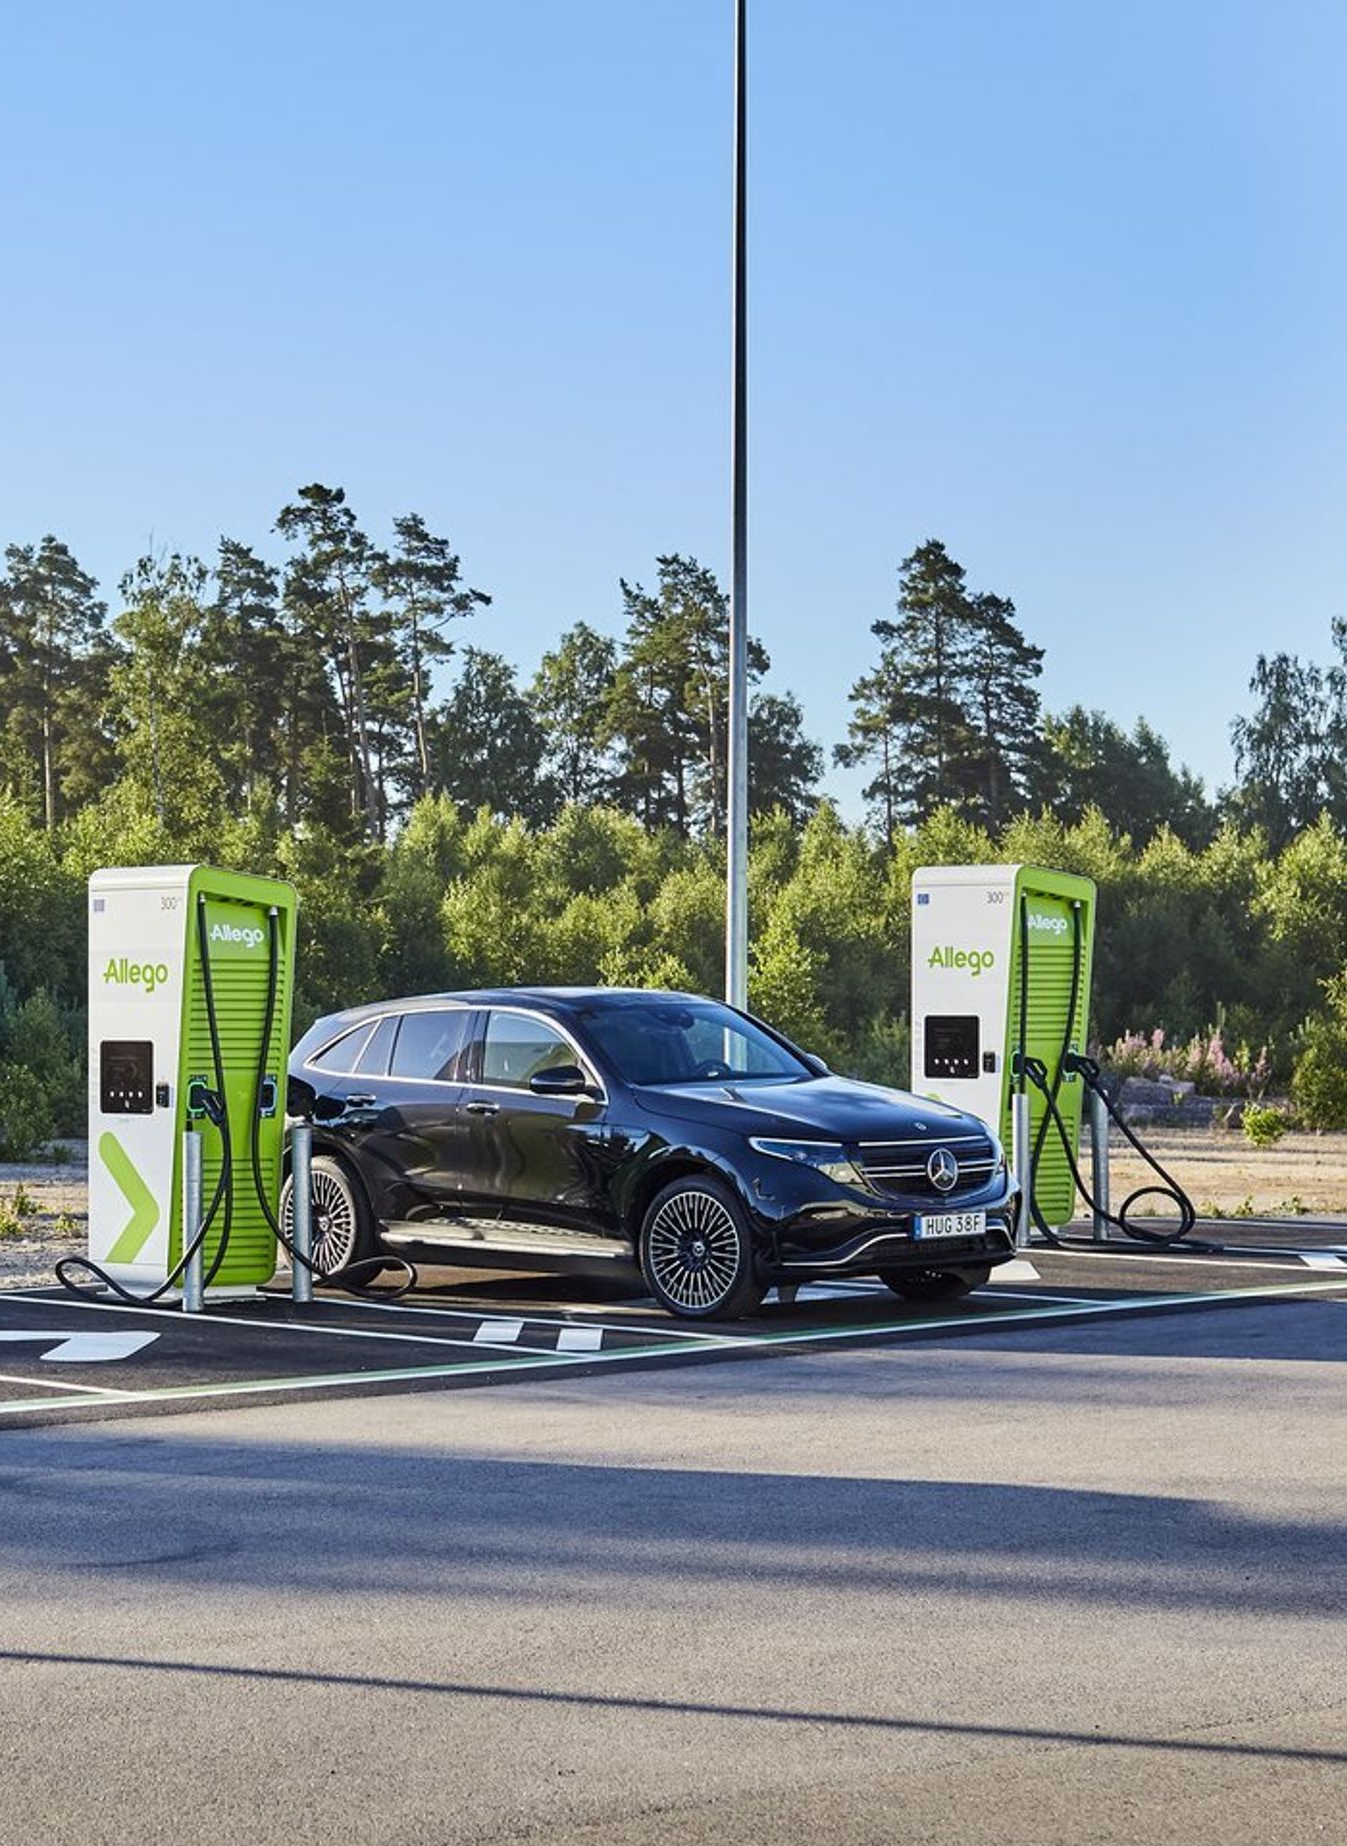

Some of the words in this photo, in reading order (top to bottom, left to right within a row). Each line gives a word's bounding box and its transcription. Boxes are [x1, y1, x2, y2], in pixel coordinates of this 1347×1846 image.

[210, 924, 264, 948] Allego
[1027, 914, 1068, 935] Allego
[927, 946, 994, 976] Allego
[103, 958, 168, 993] Allego
[926, 1217, 952, 1235] HUG
[956, 1215, 980, 1233] 38F
